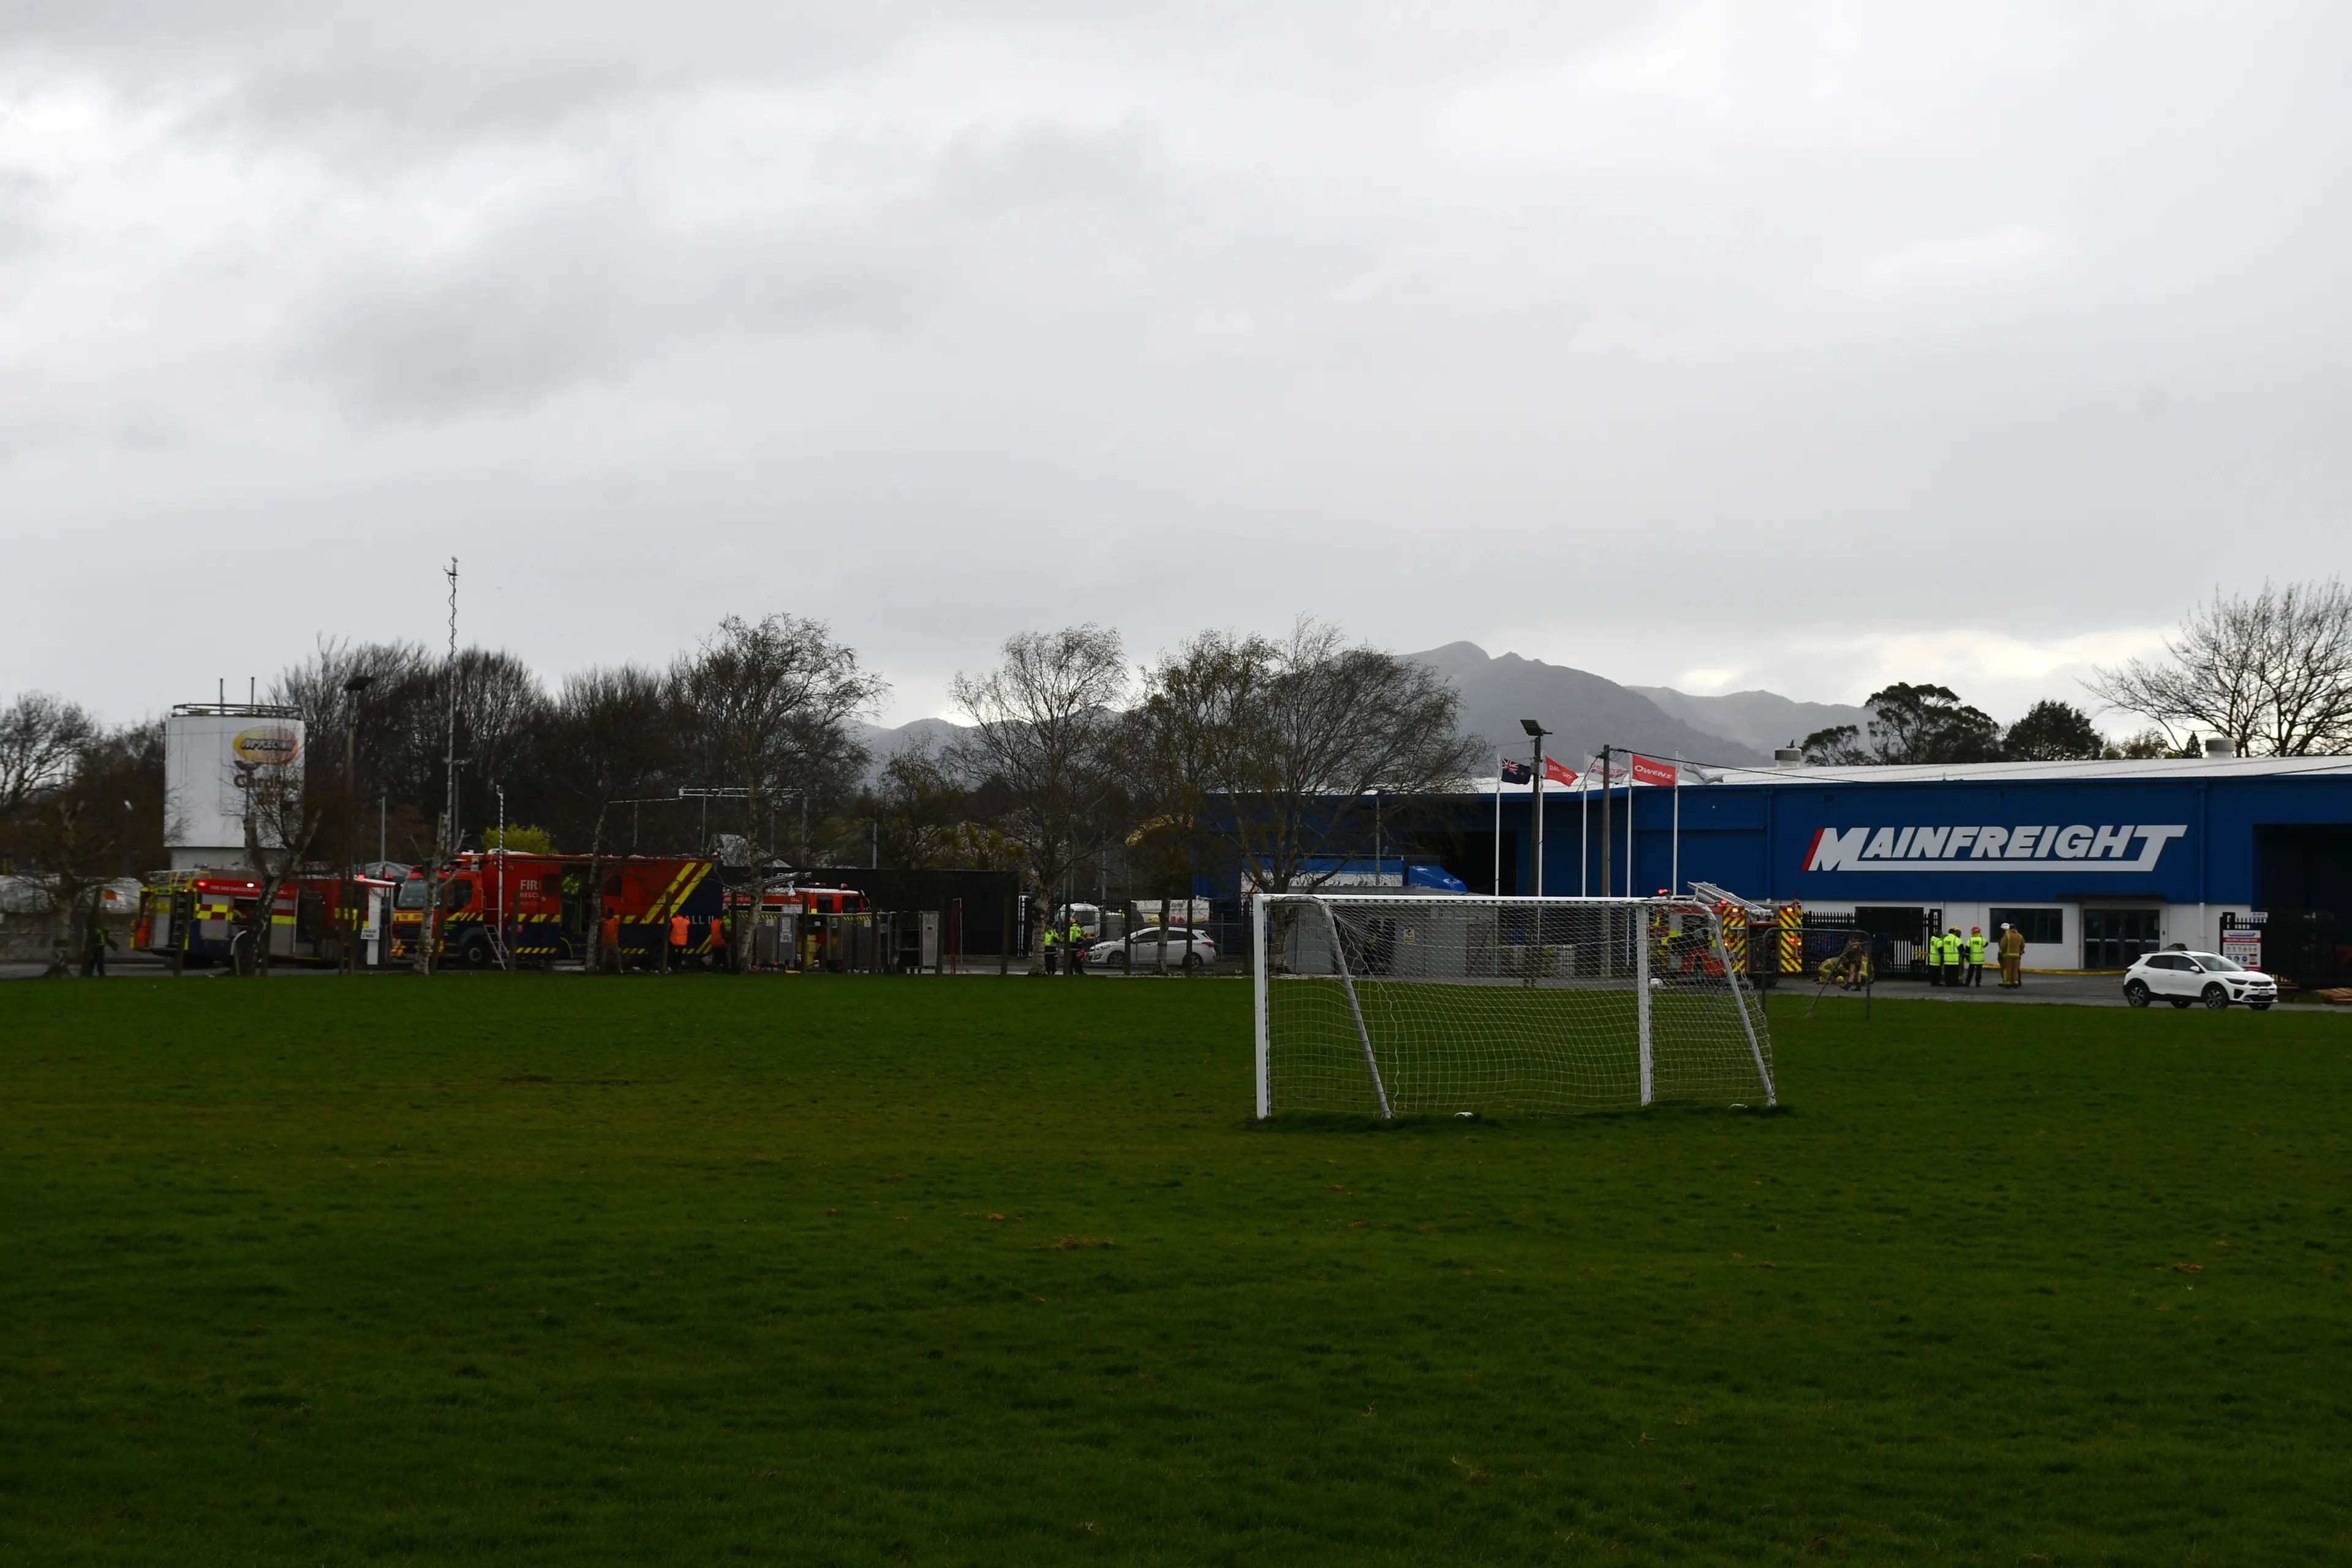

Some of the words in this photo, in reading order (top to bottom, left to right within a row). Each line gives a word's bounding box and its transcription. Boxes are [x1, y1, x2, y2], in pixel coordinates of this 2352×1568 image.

[1634, 764, 1672, 779] OWENS
[1802, 824, 2188, 872] MAINFREIGHT
[520, 880, 541, 891] FIR
